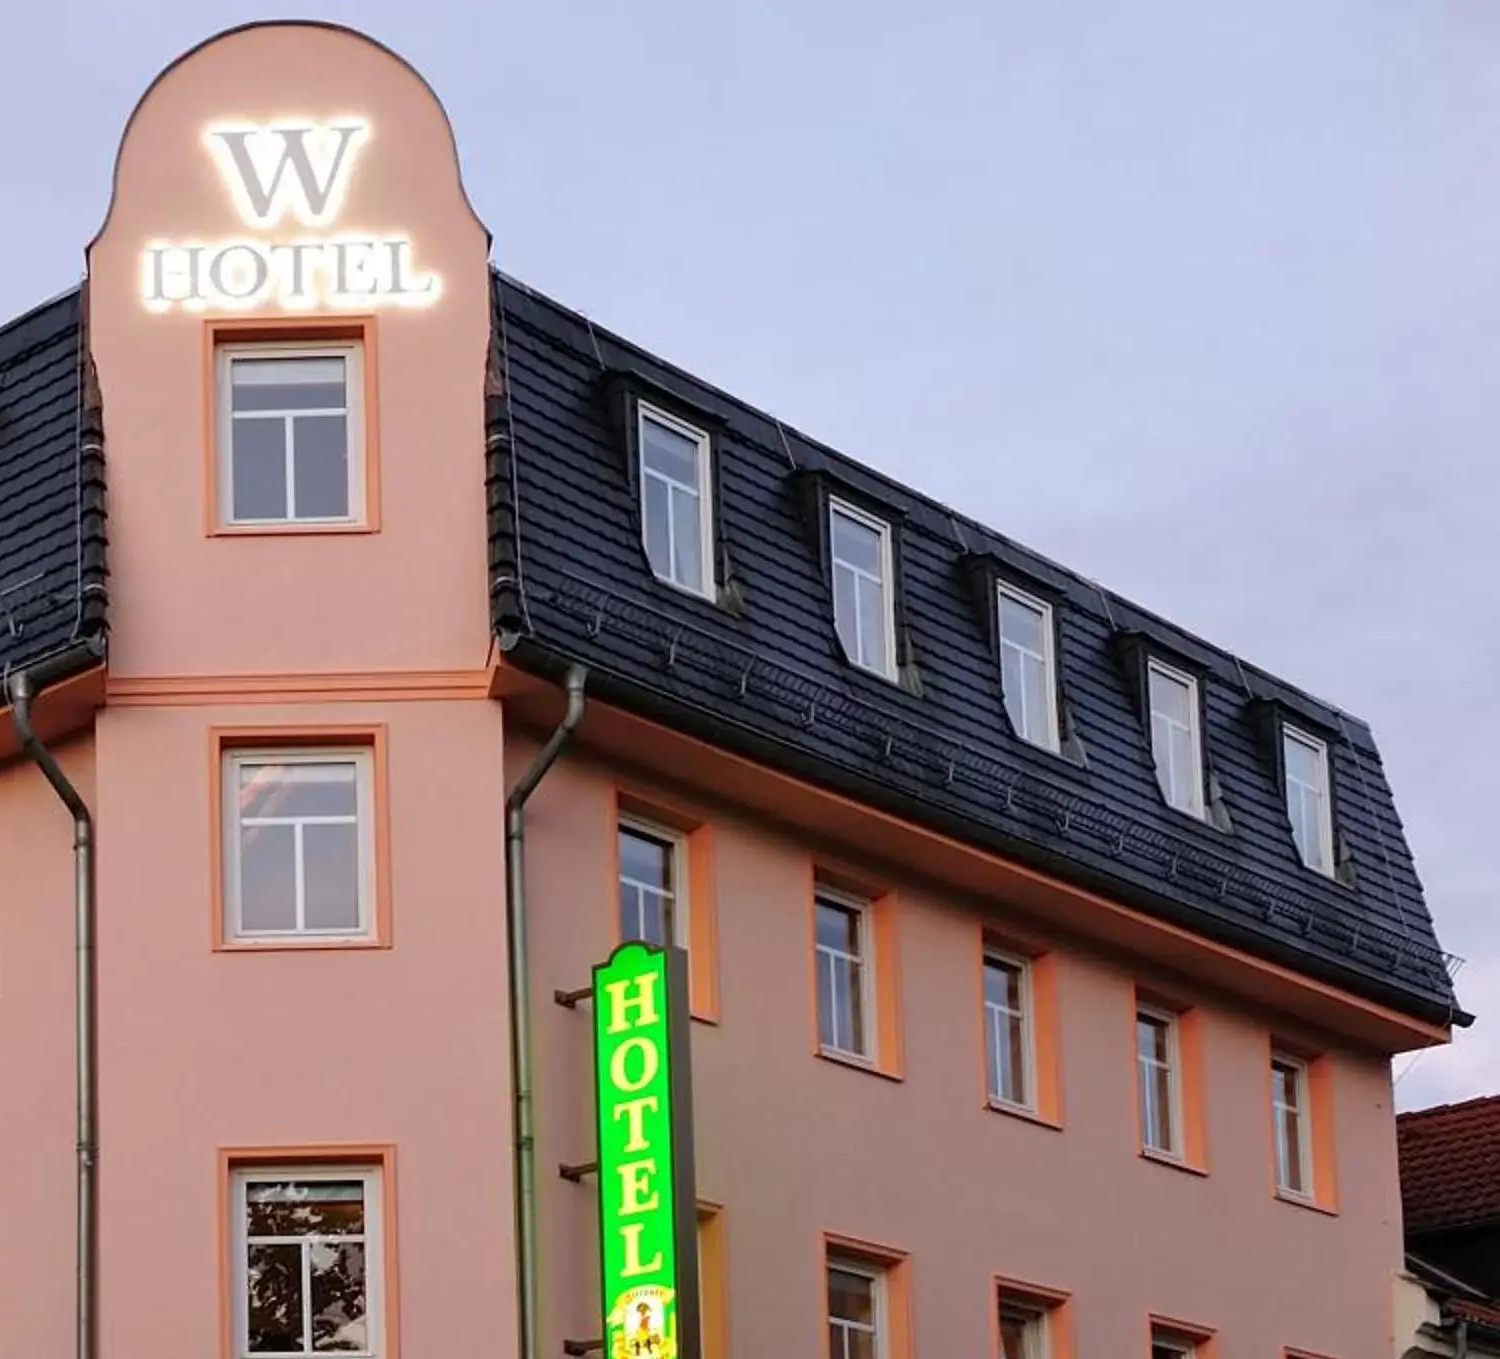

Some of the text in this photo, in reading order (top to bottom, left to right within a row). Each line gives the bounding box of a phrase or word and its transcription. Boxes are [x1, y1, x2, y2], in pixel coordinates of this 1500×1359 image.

[209, 125, 365, 219] W
[144, 240, 433, 301] HOTEL
[606, 971, 663, 1279] HOTEL
